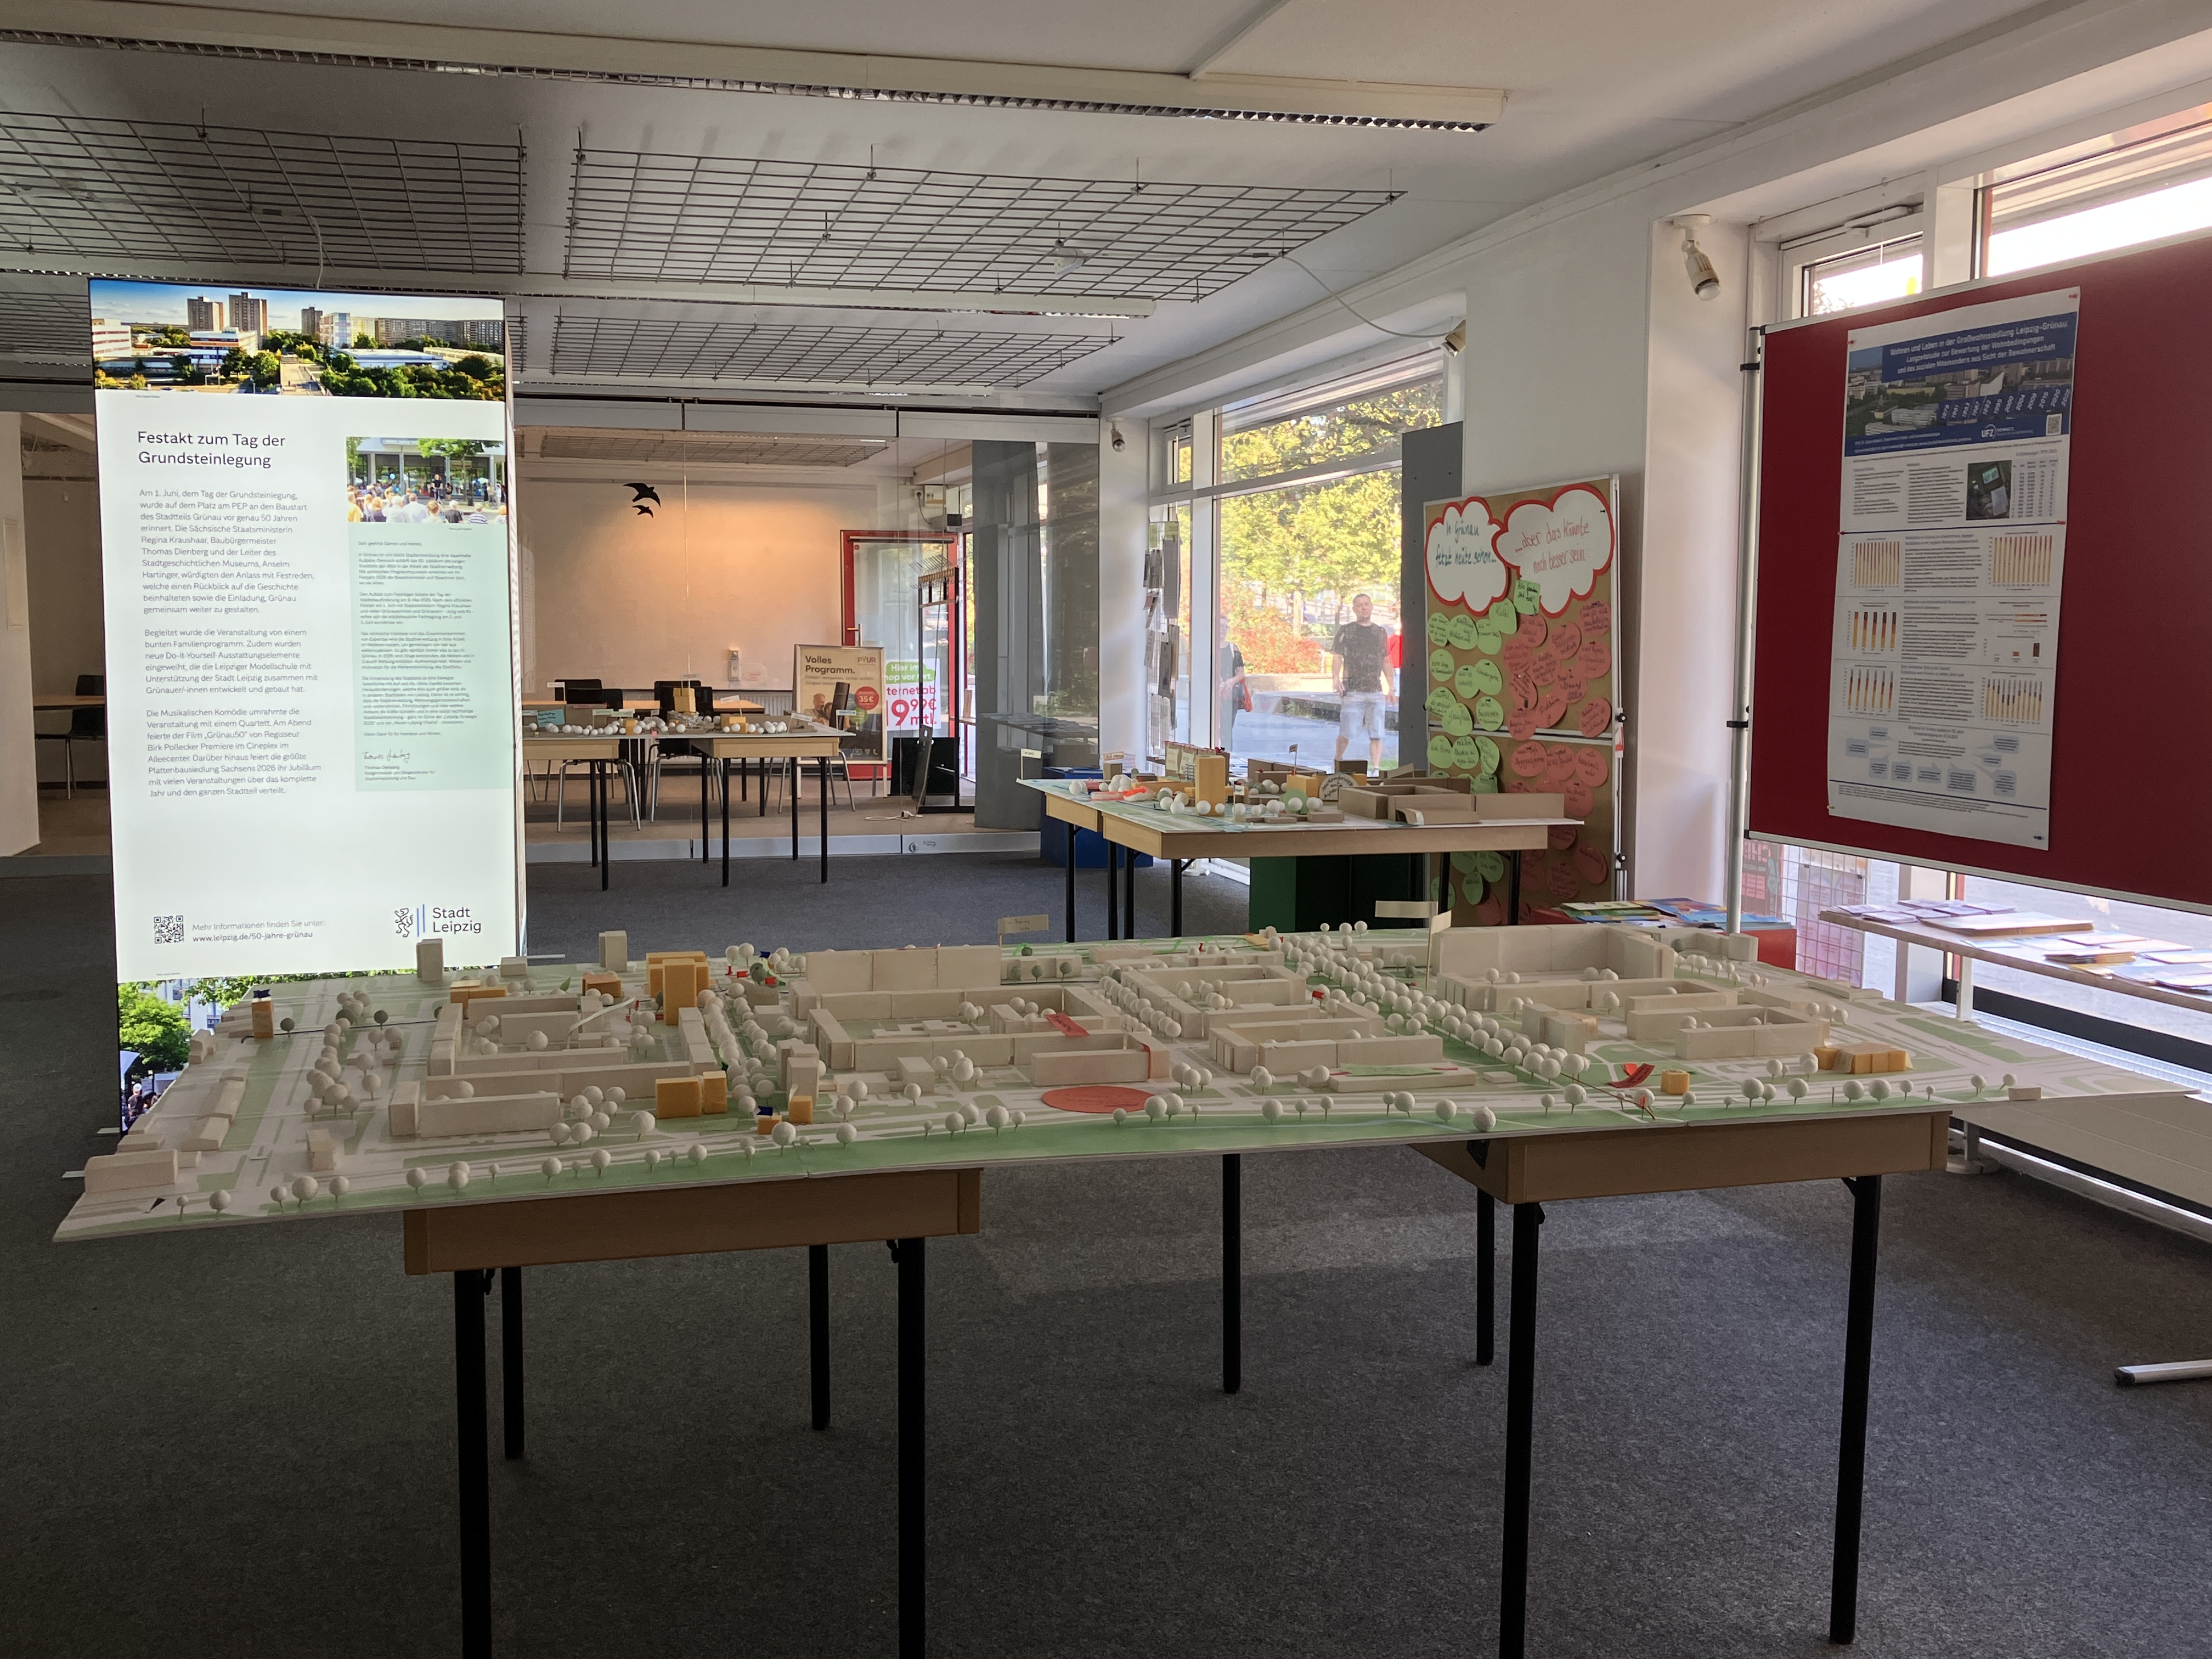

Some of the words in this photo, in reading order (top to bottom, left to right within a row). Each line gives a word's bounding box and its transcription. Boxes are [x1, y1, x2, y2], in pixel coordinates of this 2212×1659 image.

[2016, 394, 2025, 411] 2004
[2051, 389, 2061, 407] 2020
[1982, 428, 1994, 437] UFZ
[137, 431, 194, 444] Festakt
[197, 435, 228, 444] zum
[232, 433, 258, 448] Tag
[262, 435, 285, 446] der
[138, 451, 271, 468] Grundsteinlegung
[201, 489, 214, 499] Tag
[196, 501, 216, 509] Platz
[232, 525, 293, 533] Staatsministerin
[1454, 519, 1479, 544] Grünau
[1546, 522, 1561, 544] das
[140, 536, 167, 545] Regina
[210, 536, 276, 545] Baubürgermeister
[173, 548, 208, 556] Dienberg
[142, 559, 221, 568] Stadtgeschichtlichen
[1533, 552, 1547, 573] noch
[1549, 550, 1568, 569] besser
[180, 571, 219, 579] würdigten
[144, 629, 178, 637] Begleitet
[216, 629, 268, 637] Veranstaltung
[805, 655, 832, 664] Volles
[805, 665, 855, 675] Programm.
[923, 685, 936, 694] ab
[432, 906, 470, 918] Stadt
[432, 920, 481, 934] Leipzig
